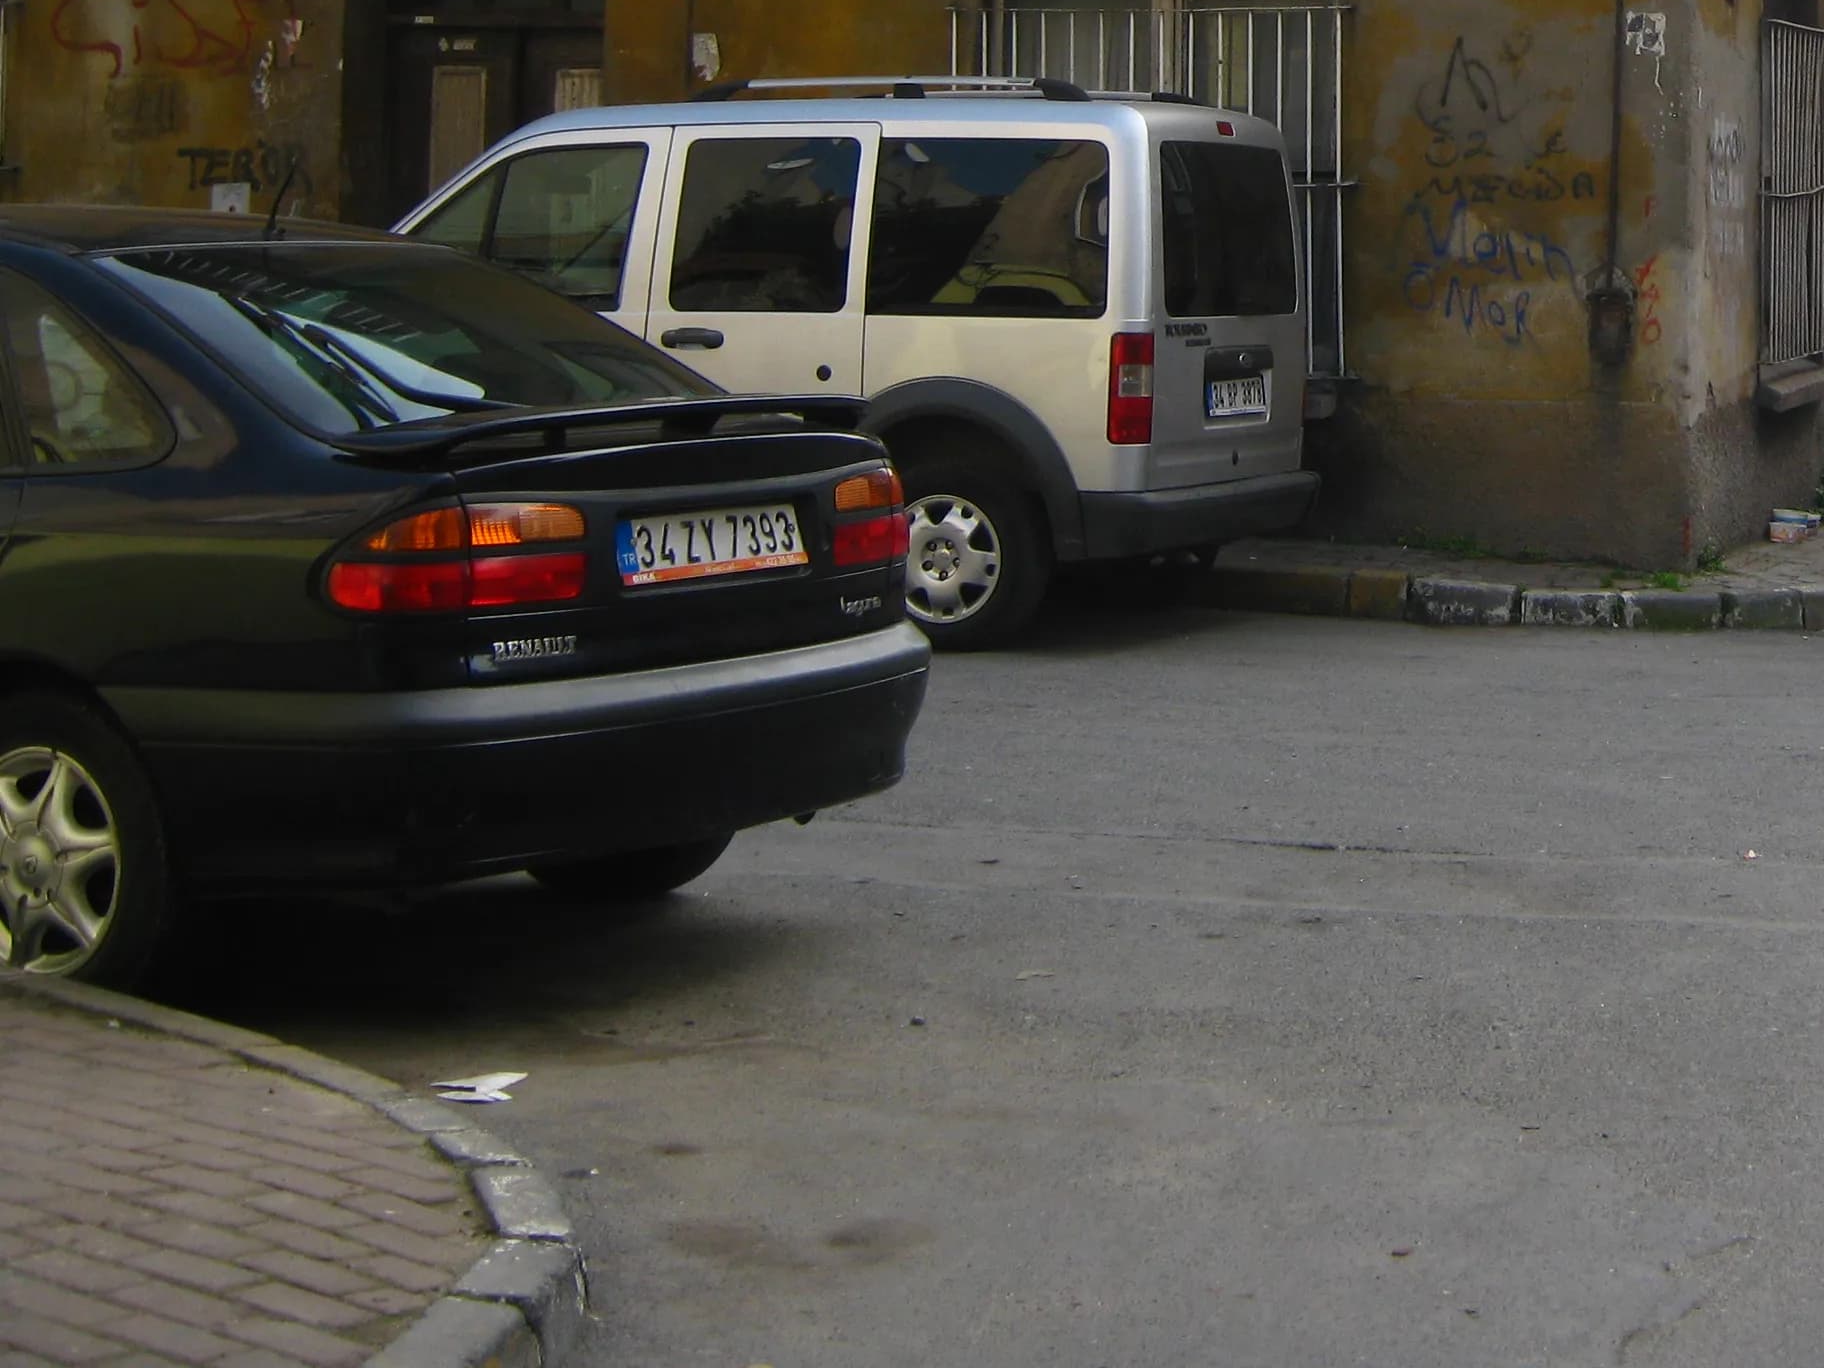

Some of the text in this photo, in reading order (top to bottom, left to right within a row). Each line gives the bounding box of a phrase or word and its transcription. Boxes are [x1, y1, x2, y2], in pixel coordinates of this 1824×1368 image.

[636, 510, 795, 569] 34 ZY 7393
[622, 553, 636, 566] TR
[492, 634, 577, 663] RENAULT
